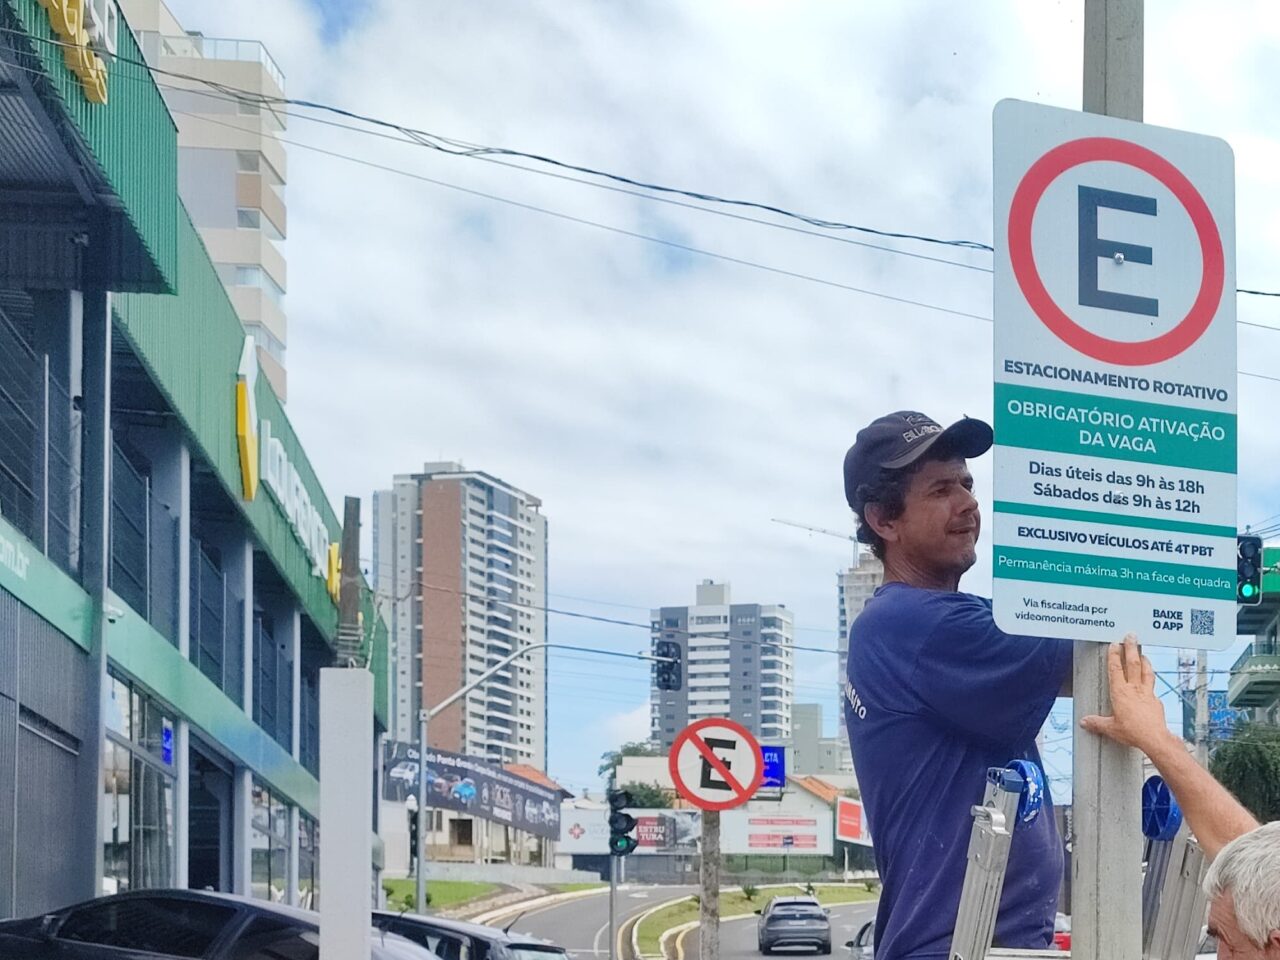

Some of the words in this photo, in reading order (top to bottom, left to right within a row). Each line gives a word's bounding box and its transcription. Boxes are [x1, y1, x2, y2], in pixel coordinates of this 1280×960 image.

[1078, 185, 1159, 317] E
[1004, 359, 1150, 391] ESTACIONAMENTO
[1153, 380, 1228, 402] ROTATIVO
[1007, 399, 1134, 429] OBRIGATÓRIO
[1138, 416, 1225, 442] ATIVAÇÃO
[1079, 429, 1104, 446] DA
[1108, 432, 1156, 453] VAGA
[1029, 461, 1062, 478] Dias
[1066, 465, 1103, 482] úteis
[1106, 471, 1133, 486] das
[1136, 474, 1155, 489] 9h
[1158, 475, 1175, 491] às
[1178, 479, 1205, 495] 18h
[1033, 482, 1099, 503] Sábados
[1102, 491, 1129, 506] das
[1132, 494, 1152, 508] 9h
[1155, 496, 1172, 511] às
[1175, 499, 1201, 514] 12h
[1017, 526, 1087, 544] EXCLUSIVO
[1089, 533, 1149, 551] VEÍCULOS
[1150, 538, 1173, 554] ATÉ
[1174, 543, 1190, 555] 4T
[1191, 545, 1215, 558] PBT
[998, 555, 1072, 574] Permanência
[1074, 562, 1118, 579] máxima
[1120, 567, 1134, 580] 3h
[1136, 571, 1150, 581] na
[1151, 571, 1175, 584] face
[1177, 574, 1191, 586] de
[1193, 577, 1231, 591] quadra
[1014, 611, 1116, 629] videomonitoramento
[1022, 596, 1039, 608] Via
[1040, 599, 1090, 614] fiscalizada
[1091, 605, 1108, 617] por
[1152, 608, 1183, 621] BAIXE
[1152, 620, 1161, 630] O
[1162, 620, 1183, 632] APP
